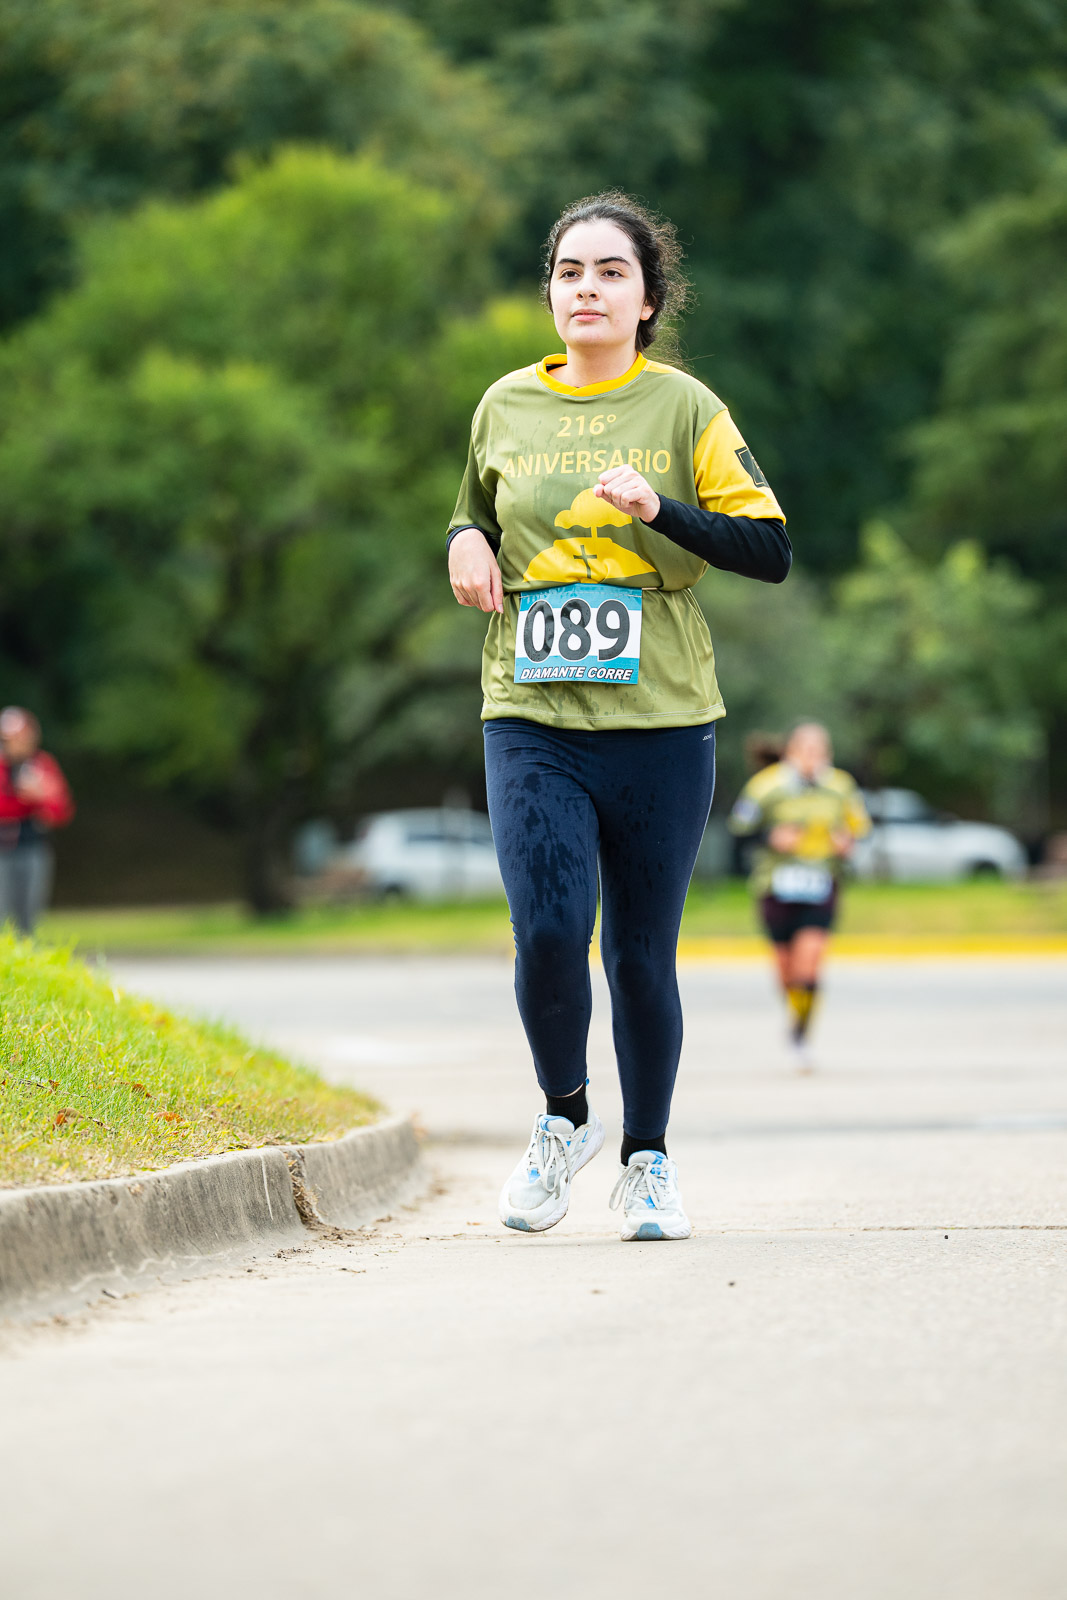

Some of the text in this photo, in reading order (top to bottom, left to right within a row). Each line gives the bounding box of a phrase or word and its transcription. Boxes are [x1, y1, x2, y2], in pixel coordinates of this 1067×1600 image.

[501, 448, 672, 479] ANIVERSARIO
[523, 597, 631, 663] 089
[520, 666, 633, 681] DIAMANTE CORRE
